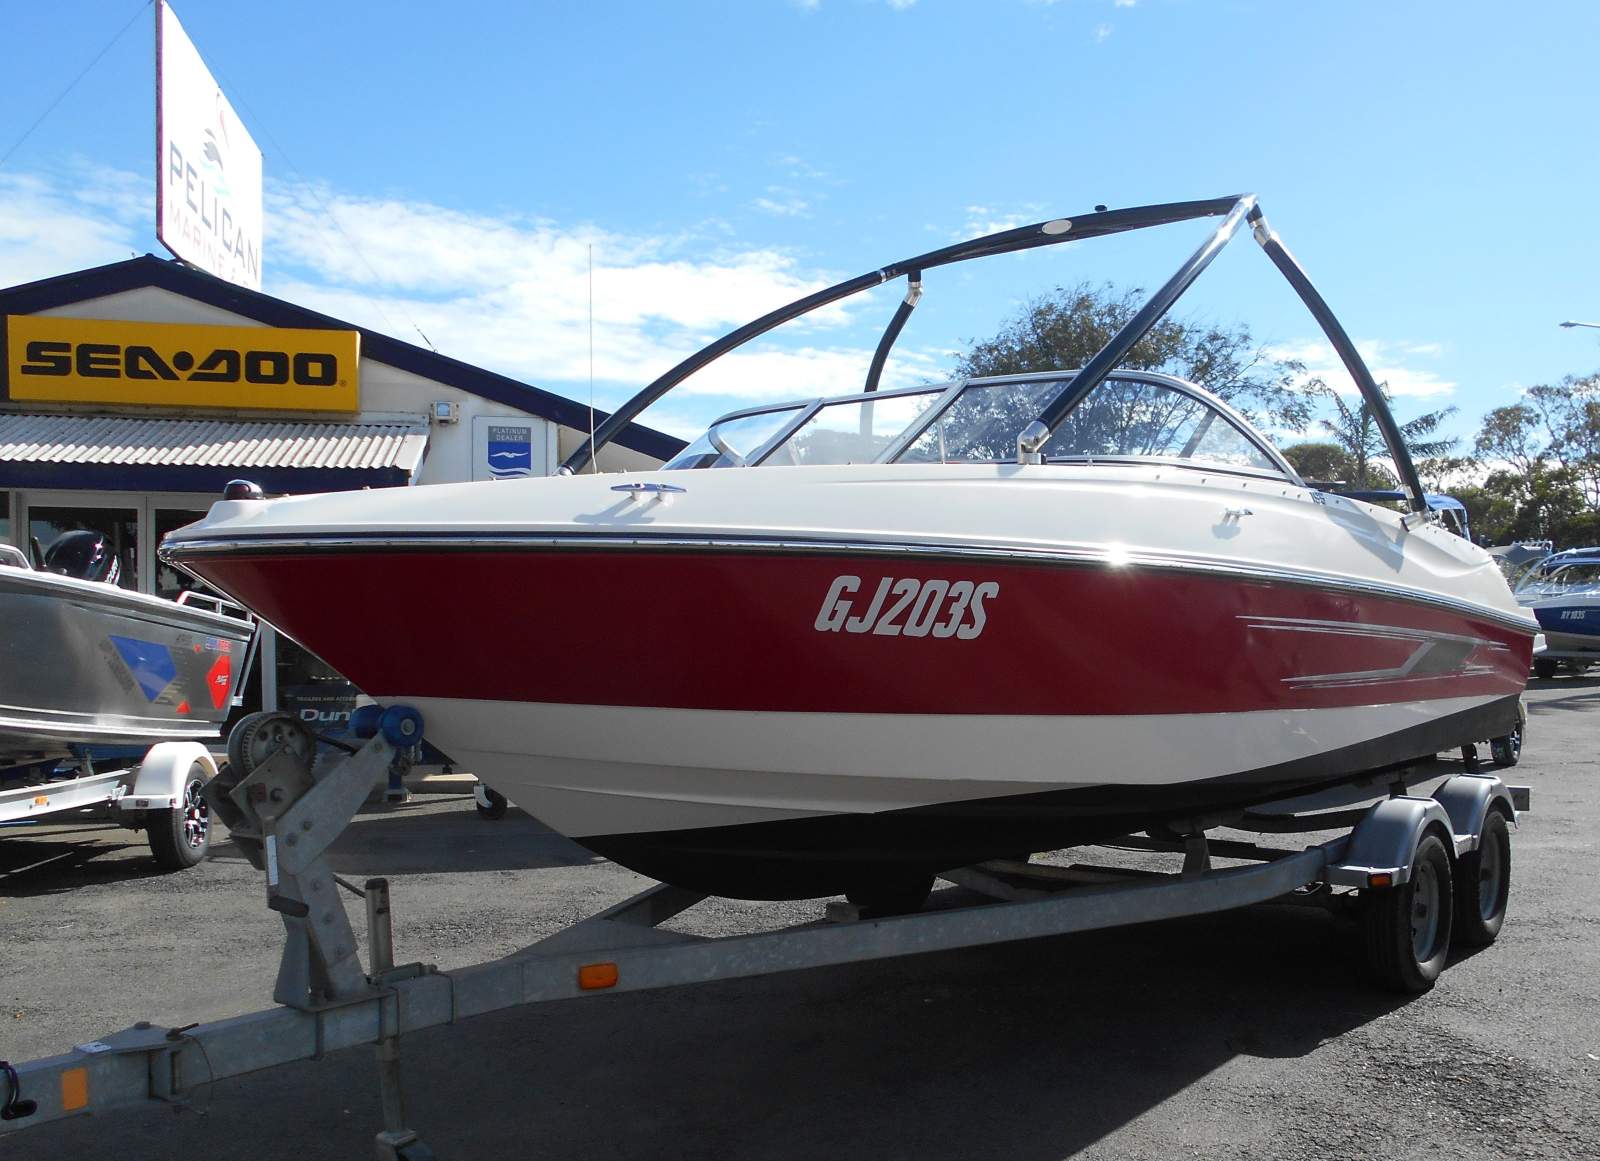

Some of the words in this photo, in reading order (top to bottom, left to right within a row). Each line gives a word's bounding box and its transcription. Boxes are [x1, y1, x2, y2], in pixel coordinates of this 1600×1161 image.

[170, 140, 258, 281] PELICAN
[170, 200, 225, 274] MARINE
[814, 575, 1000, 640] GJ203S
